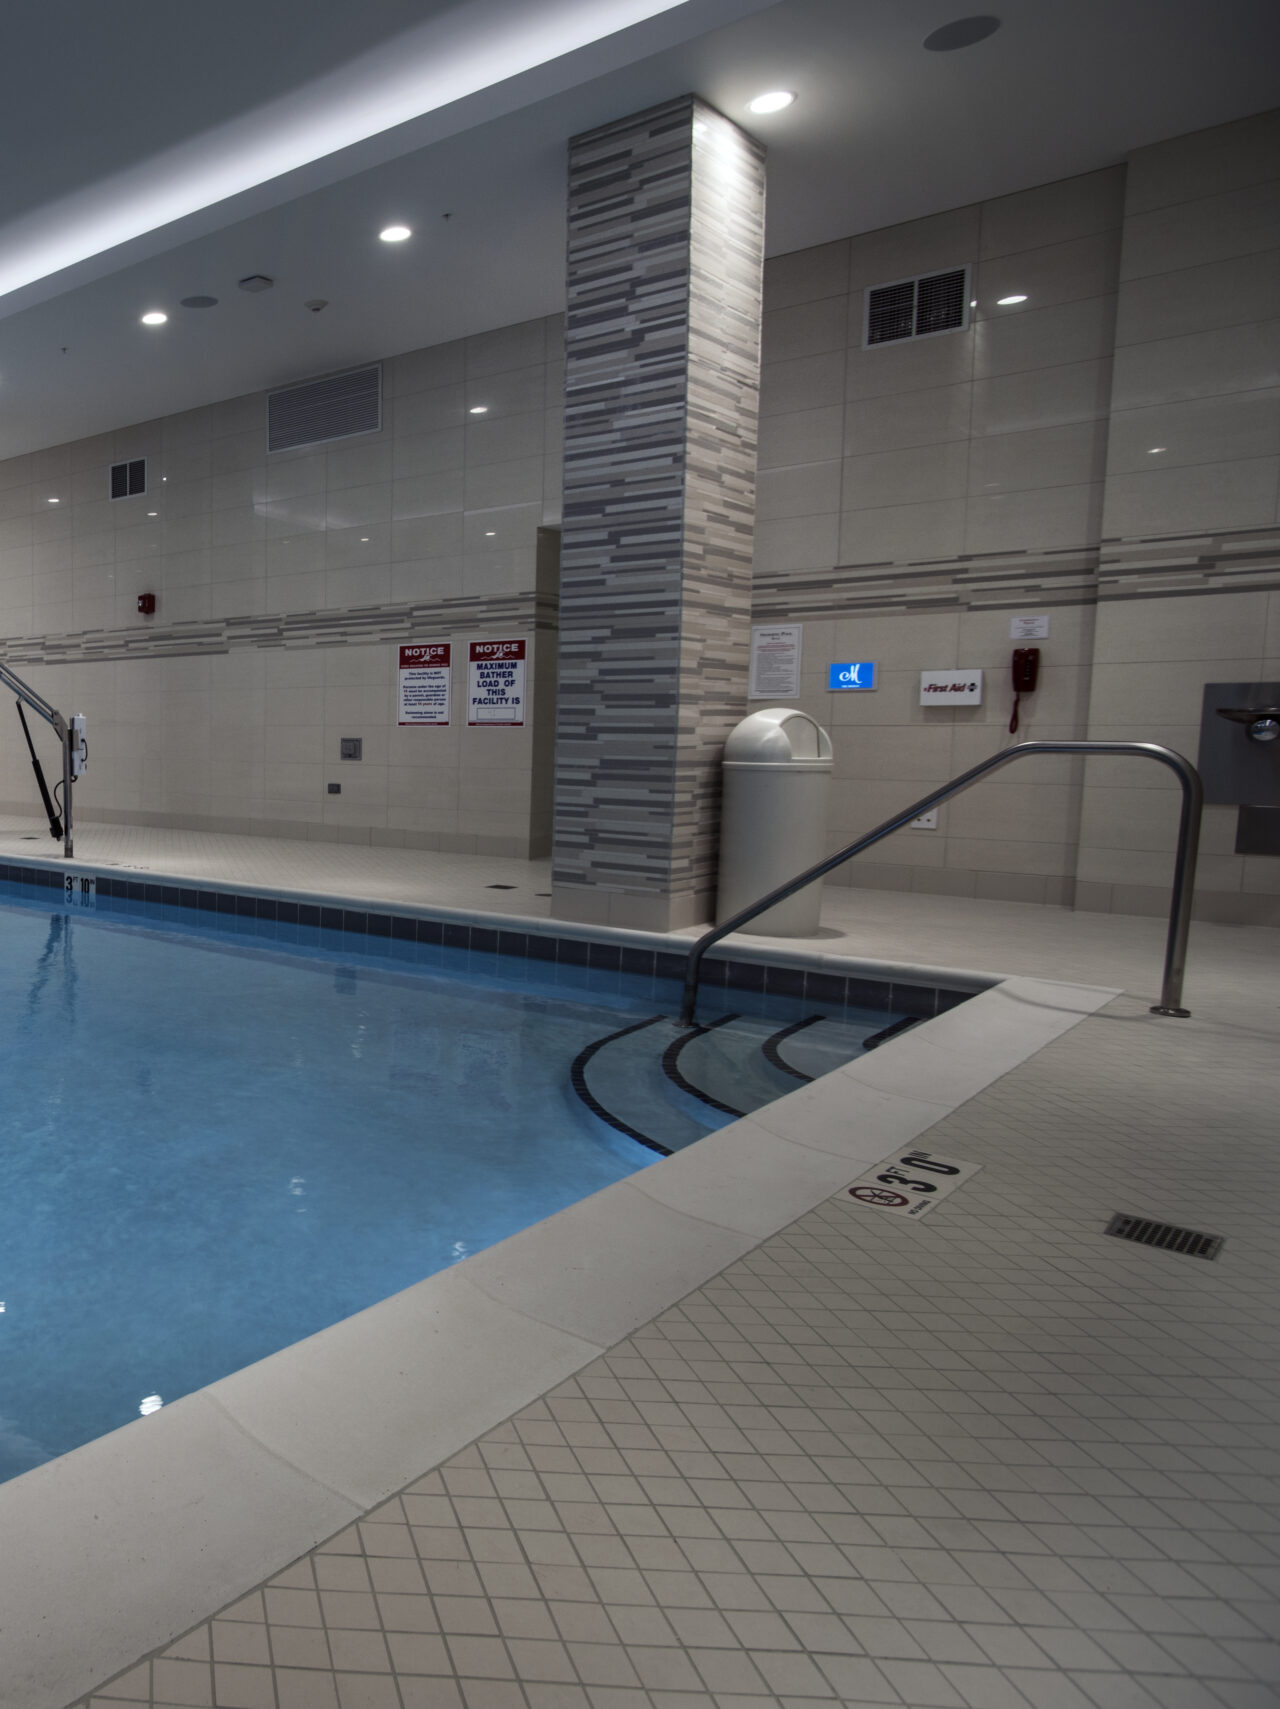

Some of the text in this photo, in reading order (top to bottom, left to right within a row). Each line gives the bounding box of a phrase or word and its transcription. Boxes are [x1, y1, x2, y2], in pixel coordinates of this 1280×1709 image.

[405, 647, 445, 656] NOTICE
[476, 643, 519, 653] NOTICE
[476, 662, 517, 670] MAXIMUM
[480, 671, 514, 679] BATHER
[477, 680, 499, 688] LOAD
[927, 683, 966, 692] First Aid
[486, 688, 506, 696] THIS
[472, 697, 509, 705] FACILITY
[66, 876, 73, 890] 3
[81, 878, 90, 893] 10
[885, 1166, 910, 1177] FT
[876, 1174, 938, 1193] 3
